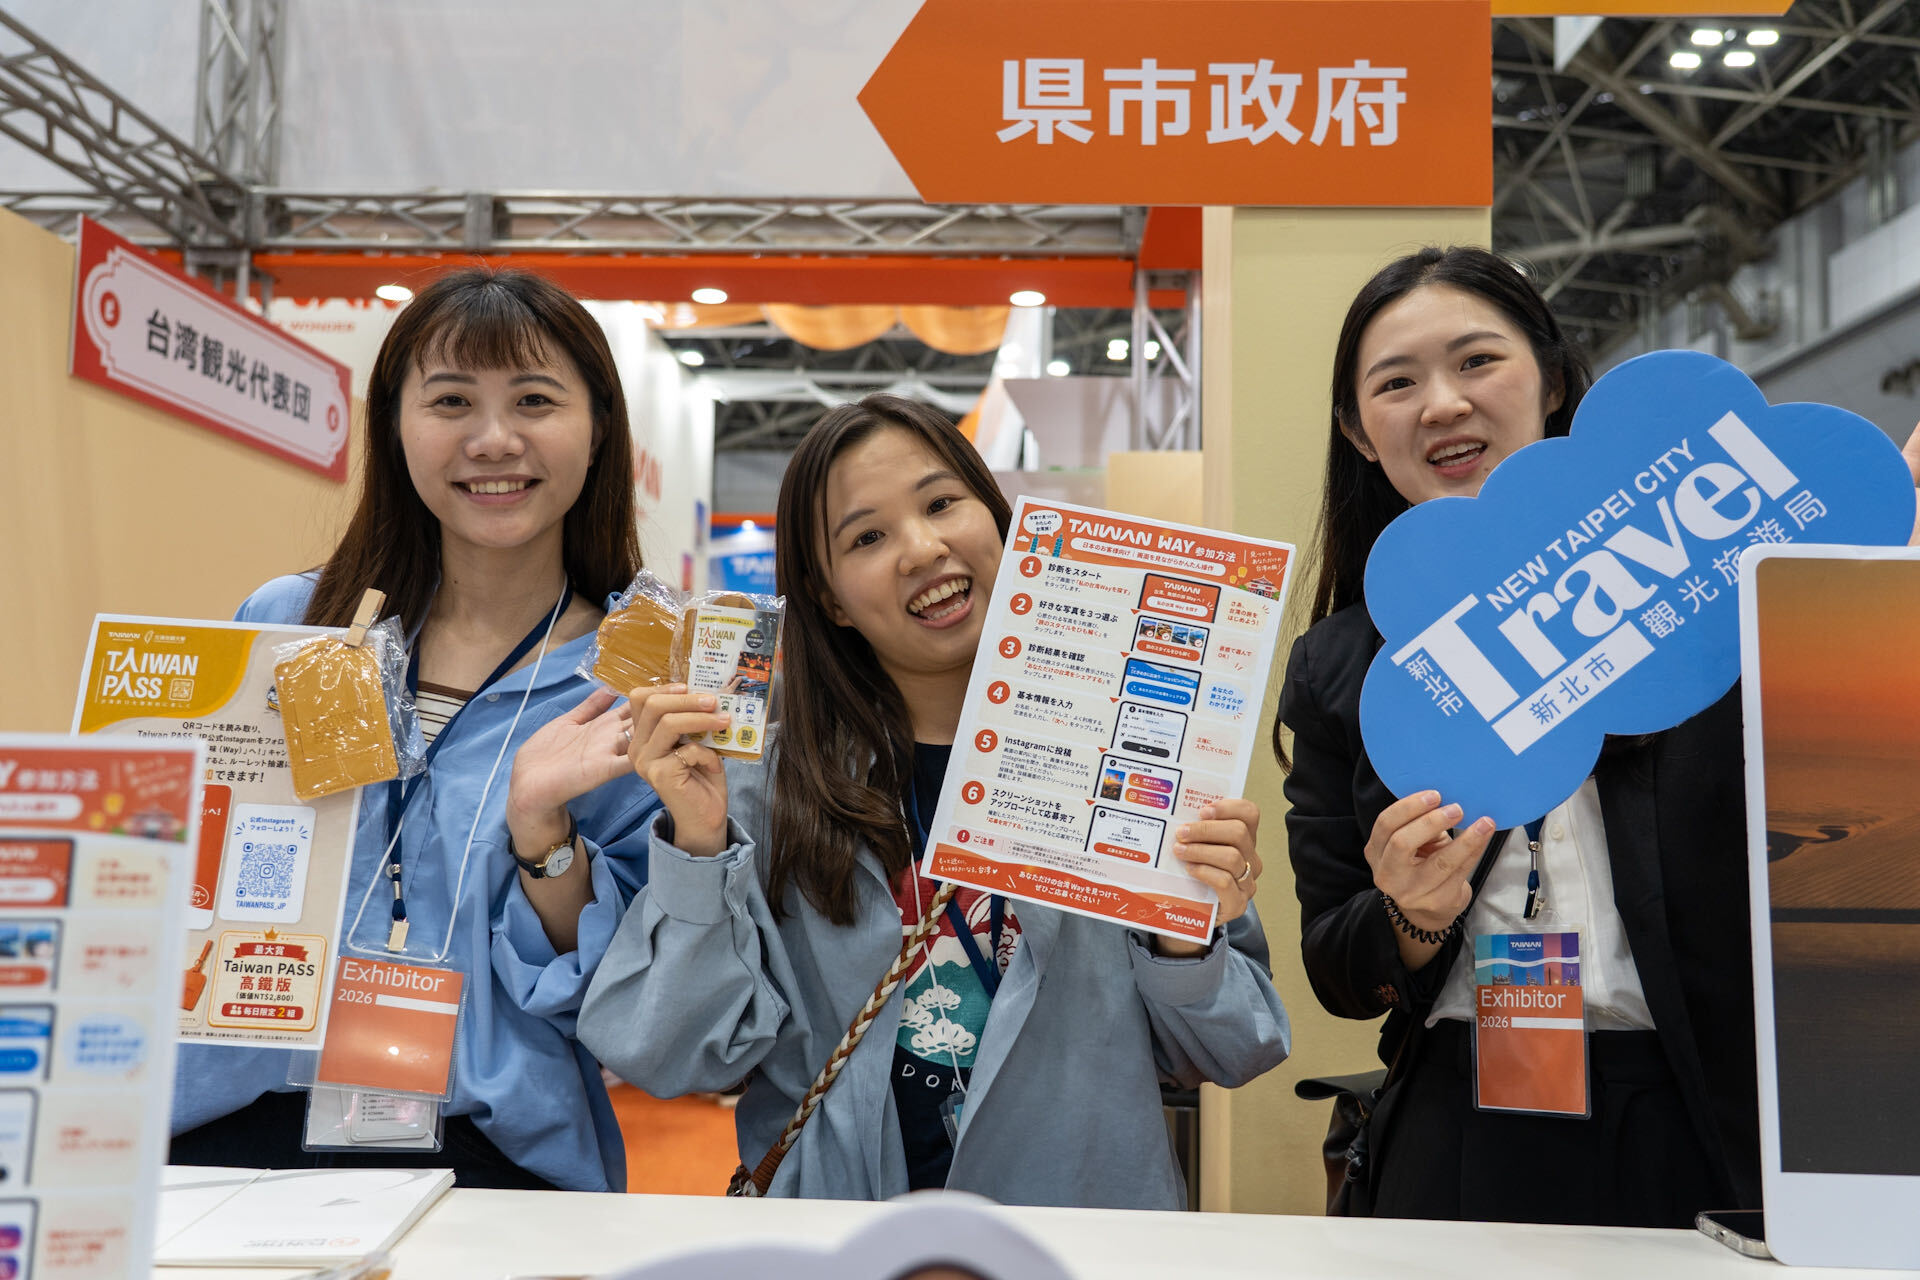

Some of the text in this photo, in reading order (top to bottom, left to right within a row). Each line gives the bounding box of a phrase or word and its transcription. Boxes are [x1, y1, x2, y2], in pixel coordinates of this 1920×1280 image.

[996, 58, 1408, 146] 県市政府
[147, 309, 312, 422] 台湾観光代表団
[1486, 438, 1695, 612] NEW TAIPEI CITY
[1066, 518, 1236, 562] TAIWAN WAY 参加方法
[1025, 561, 1035, 573] 1
[1048, 564, 1102, 579] 診断をスタート
[1391, 410, 1799, 722] Travel
[1163, 582, 1200, 594] TAIWAN
[1015, 597, 1027, 610] 2
[699, 626, 736, 640] TAIWAN
[698, 637, 722, 649] PASS
[1004, 641, 1015, 654] 3
[1028, 644, 1085, 661] 診断結果を確認
[107, 647, 199, 676] TAIWAN
[102, 671, 162, 699] PASS
[992, 685, 1004, 699] 4
[1212, 687, 1233, 695] あなたの
[1405, 653, 1464, 717] 新北市
[1529, 652, 1615, 726] 新北市
[1016, 691, 1073, 709] 基本情報を入力
[182, 722, 261, 733] QRコードを読み取り、
[980, 734, 991, 748] 5
[1004, 736, 1072, 757] Instagramに投稿
[967, 786, 979, 800] 6
[992, 789, 1061, 810] スクリーンショットを
[990, 798, 1075, 823] アップロードして応募完了
[250, 816, 296, 825] 公式Instagramを
[973, 835, 994, 846] ご注意
[1034, 884, 1100, 905] ぜひご応募ください！
[235, 900, 286, 910] TAIWANPASS_JP
[1164, 912, 1205, 927] TAIWAN
[253, 944, 285, 956] 最大賞
[1510, 941, 1542, 949] TAIWAN
[224, 960, 315, 977] Taiwan PASS
[342, 961, 445, 992] Exhibitor
[240, 976, 292, 992] 高鐵版
[338, 989, 373, 1005] 2026
[1481, 988, 1566, 1009] Exhibitor
[1481, 1015, 1509, 1028] 2026
